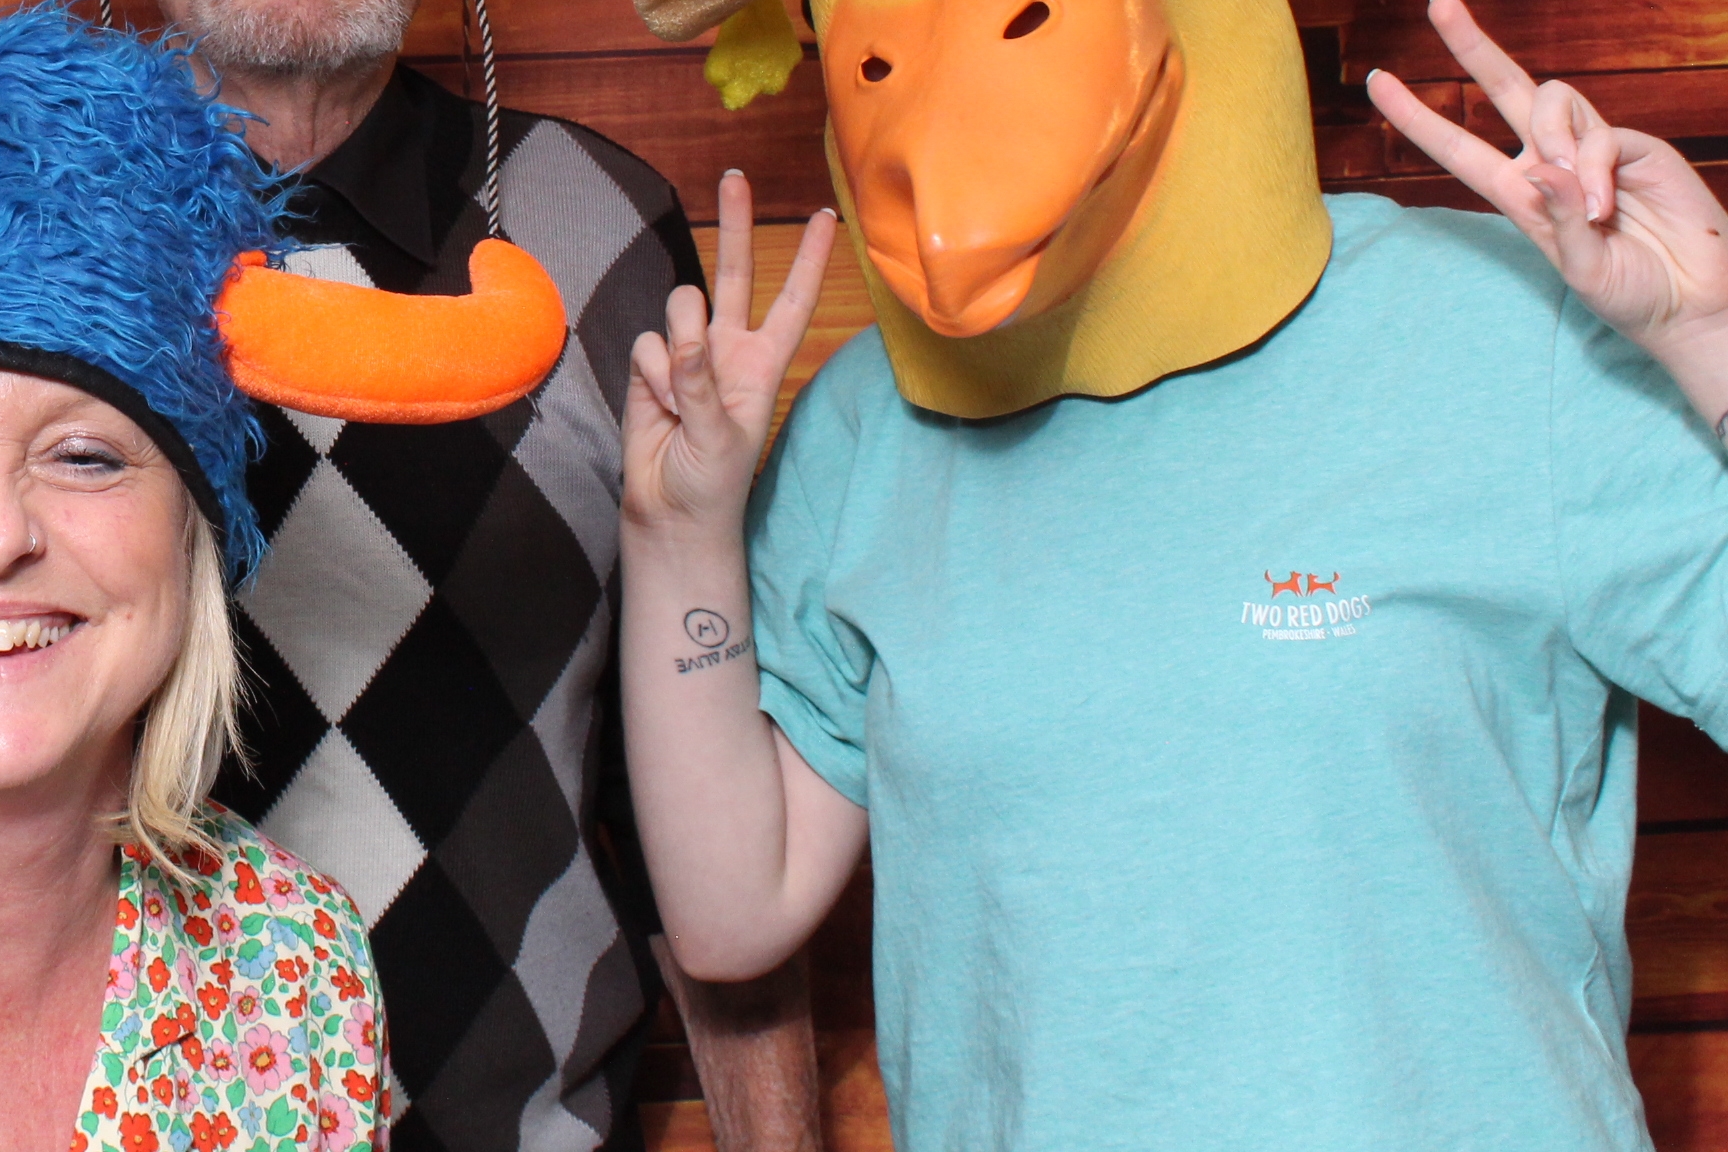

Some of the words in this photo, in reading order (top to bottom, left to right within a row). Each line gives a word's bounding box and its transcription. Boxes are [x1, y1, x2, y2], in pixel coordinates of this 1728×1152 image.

[1241, 601, 1282, 627] TWO
[1287, 604, 1323, 628] RED
[1325, 594, 1372, 625] DOGS
[1262, 628, 1326, 641] PEMBROKESHIRE
[1331, 624, 1357, 638] WALES
